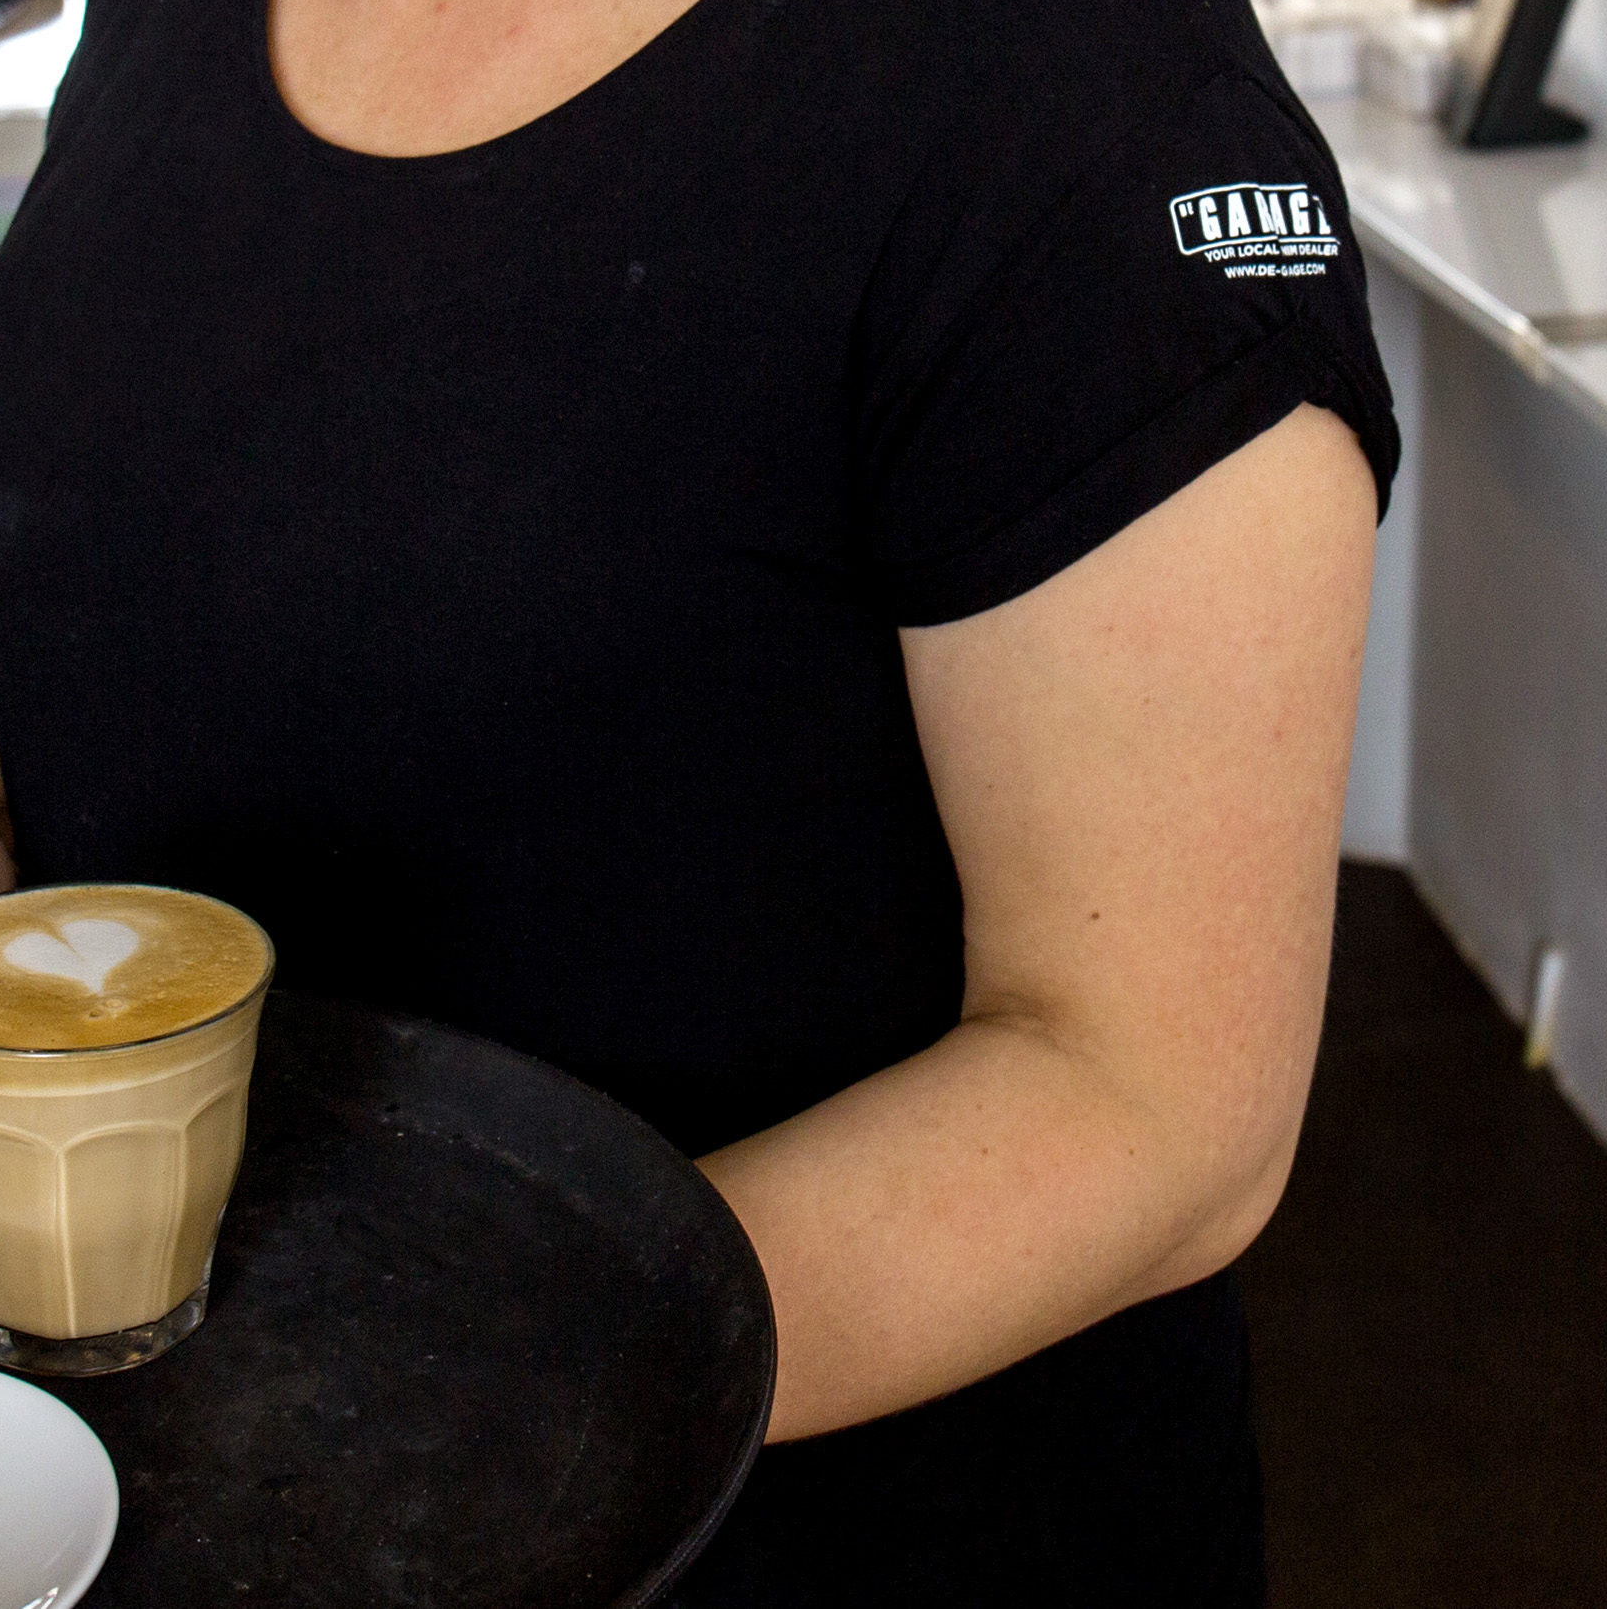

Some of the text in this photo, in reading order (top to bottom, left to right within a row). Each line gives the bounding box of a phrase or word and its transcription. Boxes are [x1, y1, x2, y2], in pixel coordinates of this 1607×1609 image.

[1204, 246, 1235, 262] YOUR
[1238, 243, 1280, 257] LOCAL
[1298, 244, 1339, 256] DEALER
